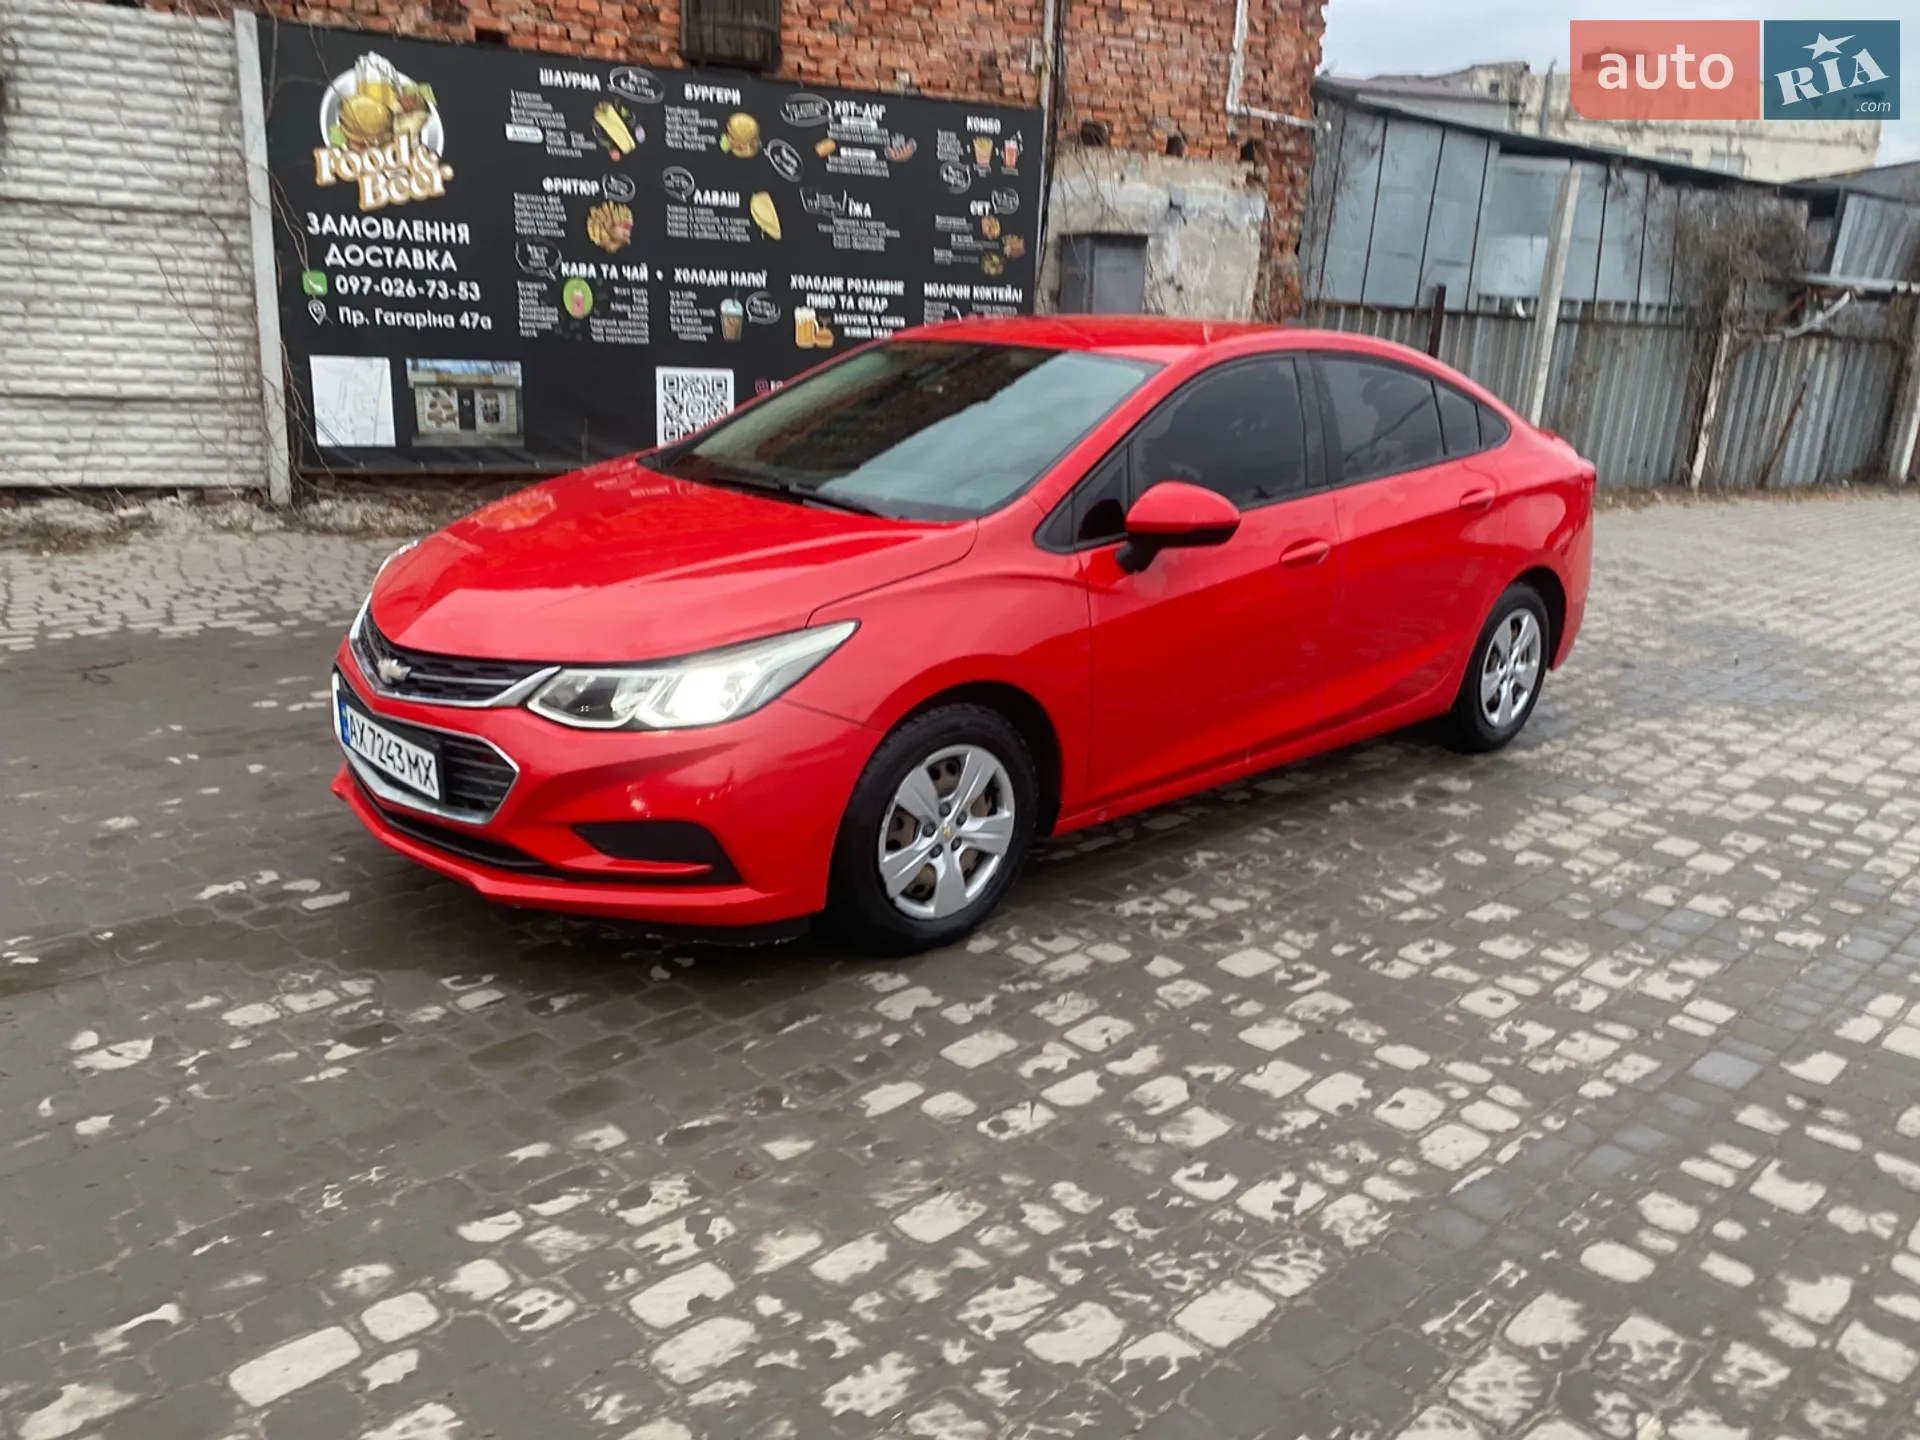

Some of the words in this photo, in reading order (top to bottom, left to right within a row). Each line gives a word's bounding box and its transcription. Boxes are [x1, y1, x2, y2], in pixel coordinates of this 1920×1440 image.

[539, 67, 601, 92] ШАУРМА
[684, 83, 741, 106] БУРГЕРИ
[966, 115, 1001, 135] КОМБО
[542, 176, 600, 197] ФРИТЮР
[693, 188, 741, 208] ЛАВАШ
[306, 211, 470, 245] ЗАМОВЛЕННЯ
[324, 243, 458, 273] ДОСТАВКА
[560, 261, 597, 279] КАВА
[600, 263, 619, 280] ТА
[621, 262, 649, 282] ЧАЙ
[674, 267, 728, 287] ХОЛОДНІ
[730, 269, 768, 289] НАПОЇ
[335, 274, 481, 302] 097-026-73-53
[790, 274, 844, 293] ХОЛОДНЕ
[839, 295, 857, 310] ТА
[338, 305, 370, 328] Пр.
[374, 306, 455, 330] Гагаріна
